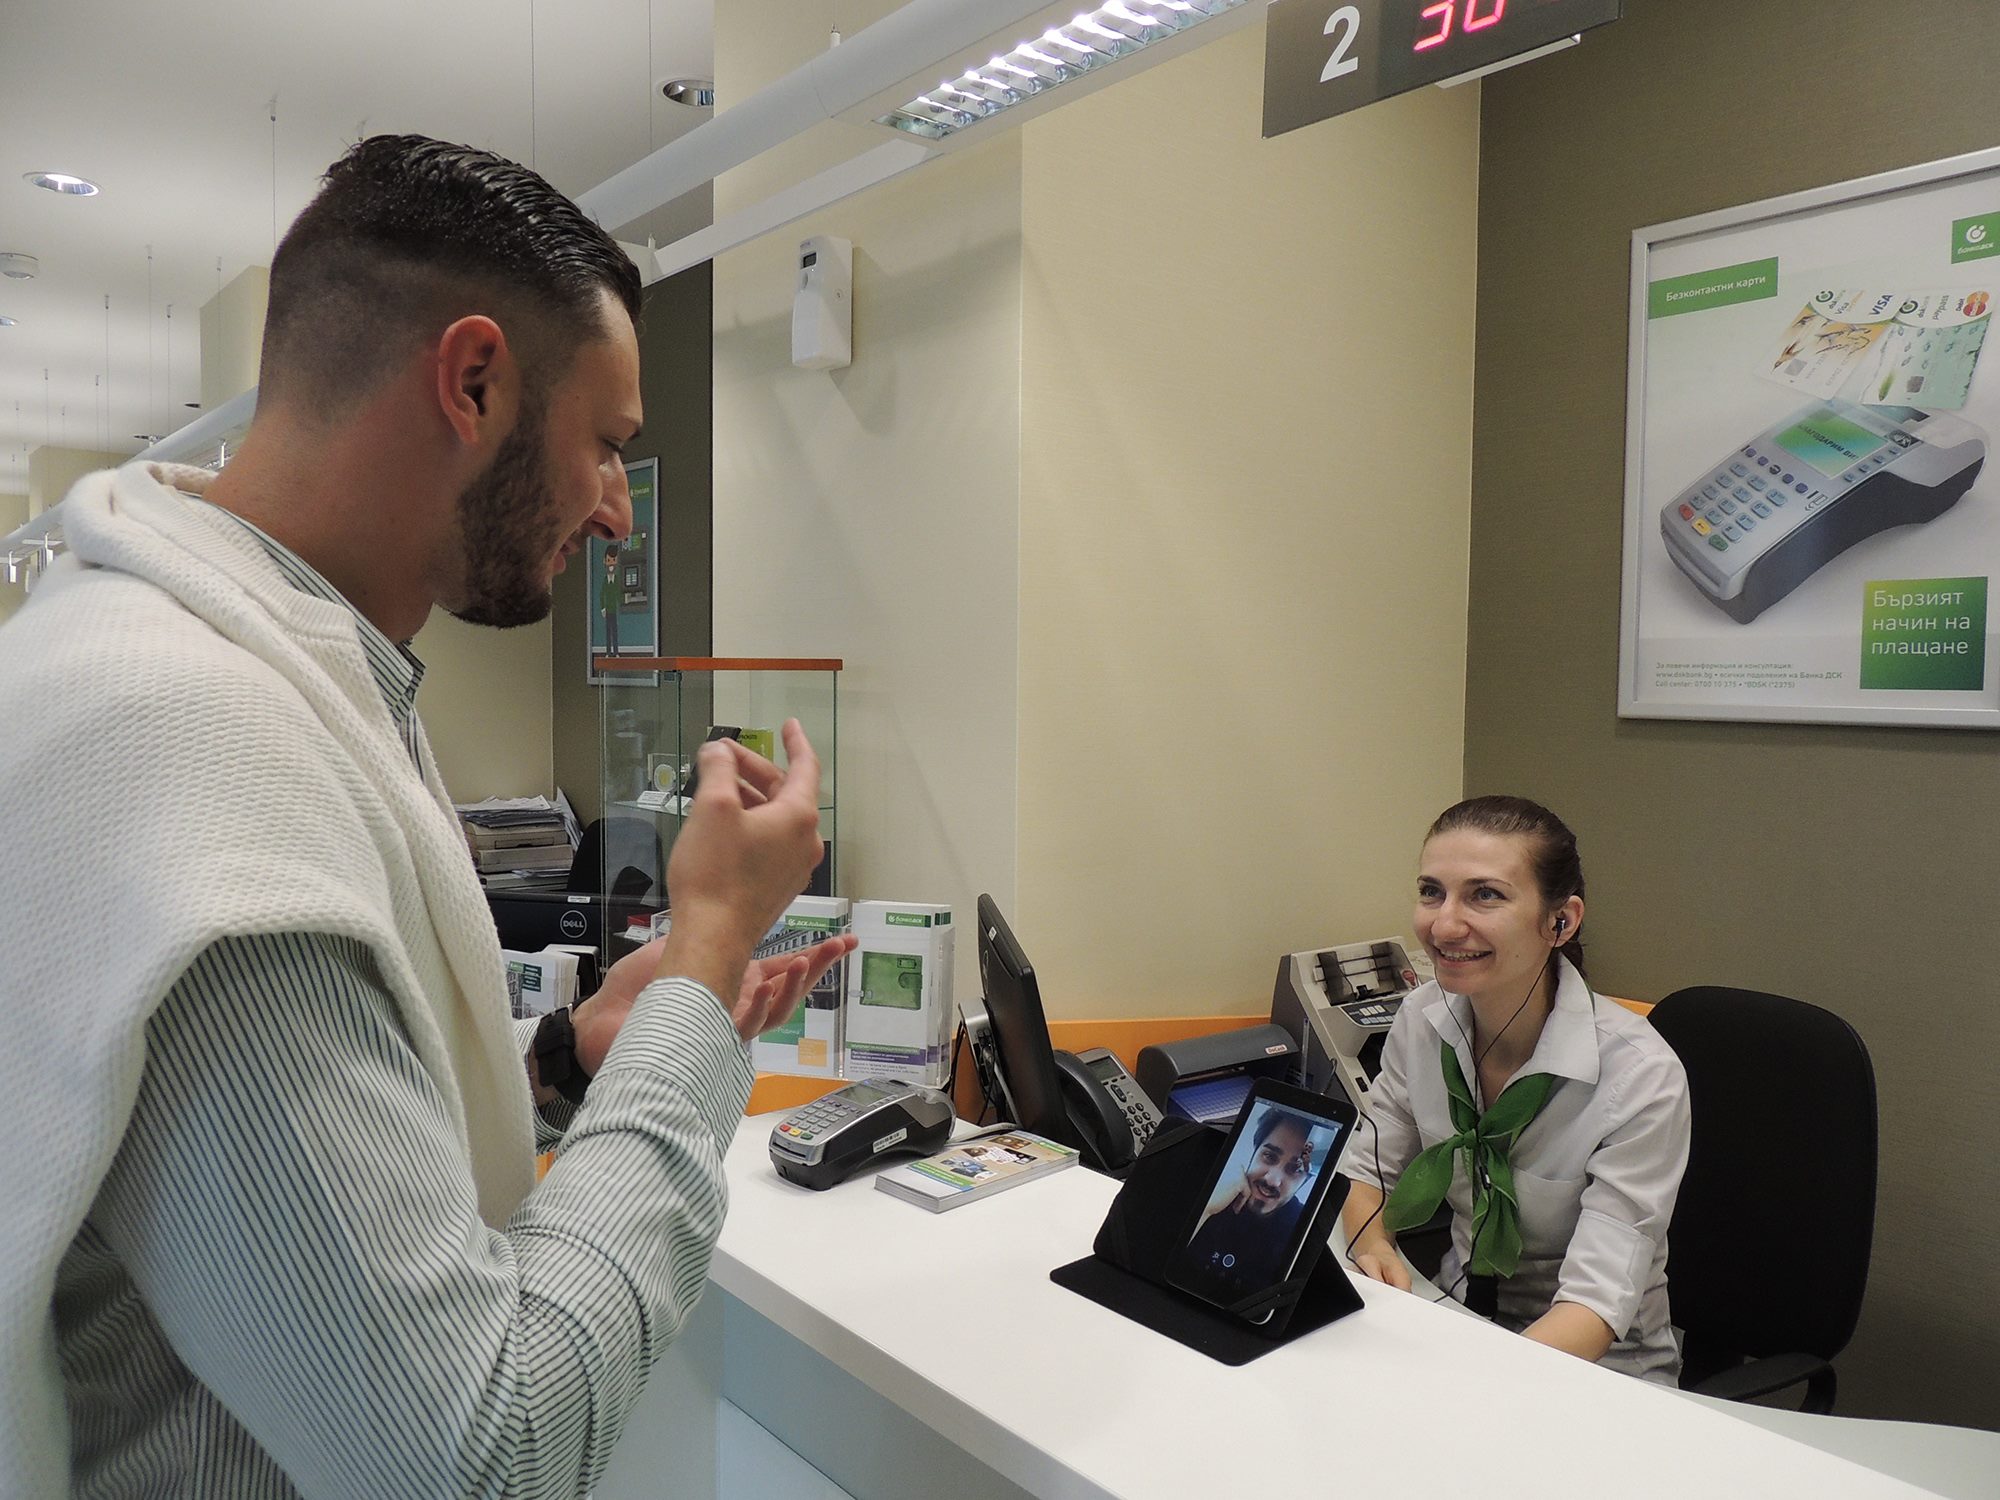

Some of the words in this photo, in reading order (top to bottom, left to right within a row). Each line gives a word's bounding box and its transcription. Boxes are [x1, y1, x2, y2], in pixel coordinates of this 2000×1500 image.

[1320, 6, 1361, 83] 2
[1666, 282, 1734, 302] Безконтактни
[1736, 276, 1766, 289] карти
[1868, 294, 1893, 315] VISA
[1874, 590, 1964, 611] Бързият
[1872, 617, 1937, 631] начин
[1945, 616, 1971, 630] на
[1871, 641, 1969, 657] плащане
[1800, 671, 1823, 679] Банка
[1825, 671, 1843, 680] ДСК
[562, 920, 584, 928] DELL
